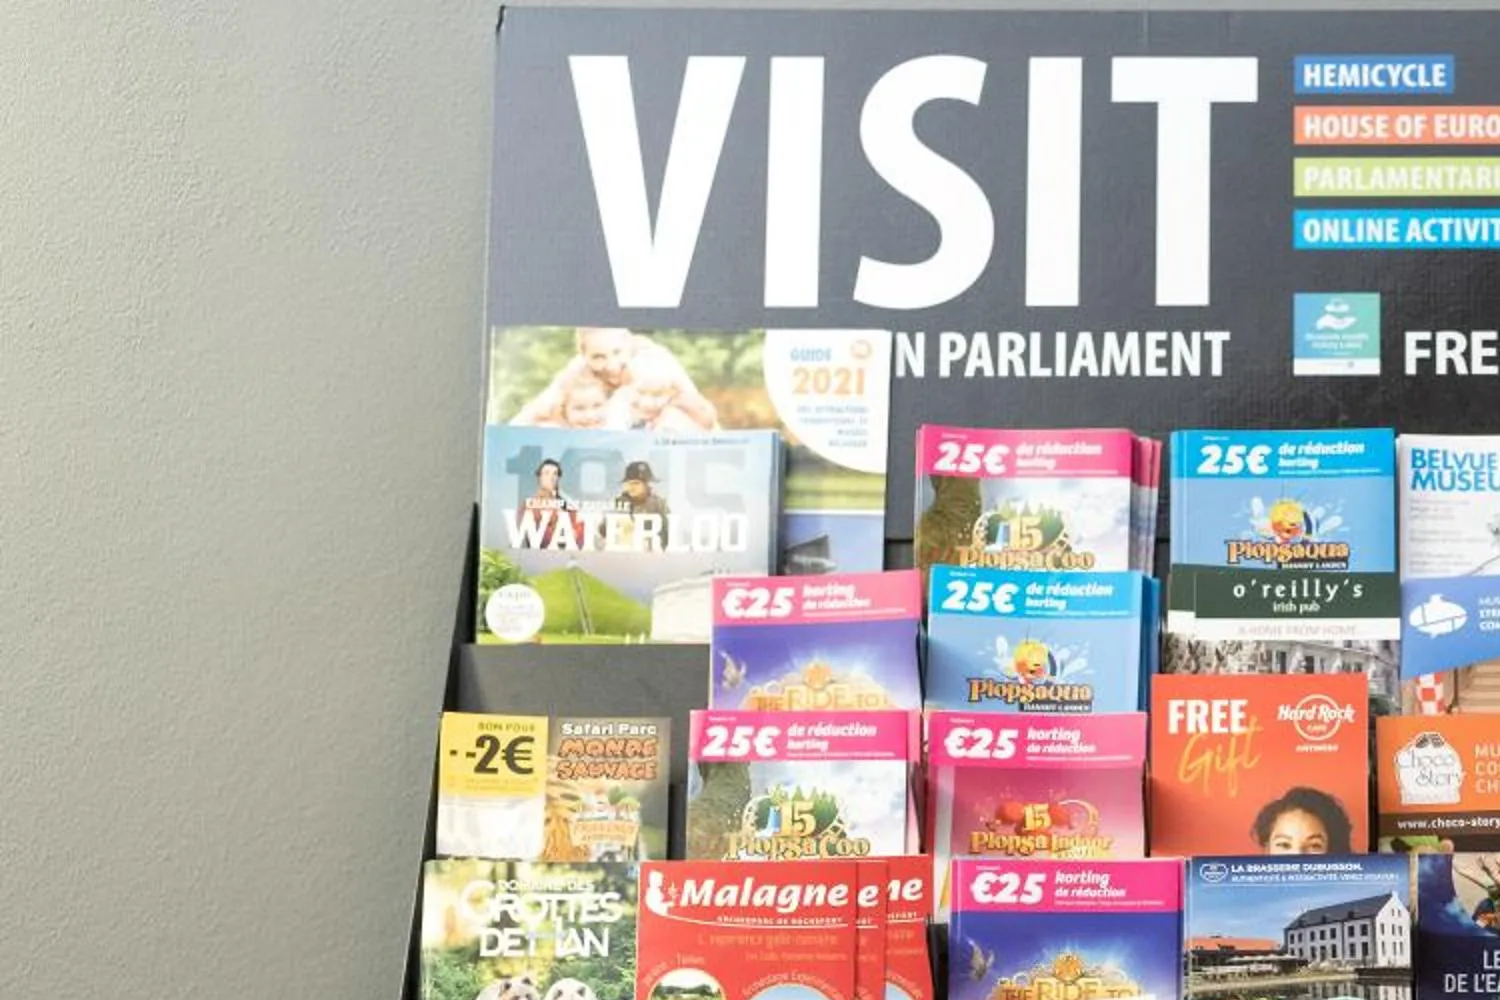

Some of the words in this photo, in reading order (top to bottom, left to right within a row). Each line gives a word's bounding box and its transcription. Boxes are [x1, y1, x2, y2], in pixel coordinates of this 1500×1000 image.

[1303, 64, 1446, 87] HEMICYCLE
[1304, 114, 1389, 138] HOUSE
[1395, 114, 1427, 137] OF
[568, 54, 1259, 309] VISIT
[1303, 218, 1399, 243] ONLINE
[790, 348, 832, 362] GUIDE
[939, 330, 1231, 377] PARLIAMENT
[792, 368, 865, 395] 2021
[934, 442, 1009, 474] 25€
[1198, 443, 1271, 476] 25€
[1279, 444, 1295, 455] de
[1299, 441, 1364, 455] réduction
[502, 509, 748, 553] WATERLOO
[722, 587, 794, 618] €25
[1233, 579, 1363, 601] o'reilly's
[1168, 700, 1248, 735] FREE
[1277, 704, 1315, 721] Hard
[1318, 704, 1355, 724] Rock
[702, 727, 779, 757] 25€
[788, 724, 807, 736] de
[810, 723, 876, 736] réduction
[944, 727, 1018, 759] €25
[1027, 727, 1080, 743] korting
[1178, 714, 1263, 796] Gift
[680, 877, 849, 911] Malagne
